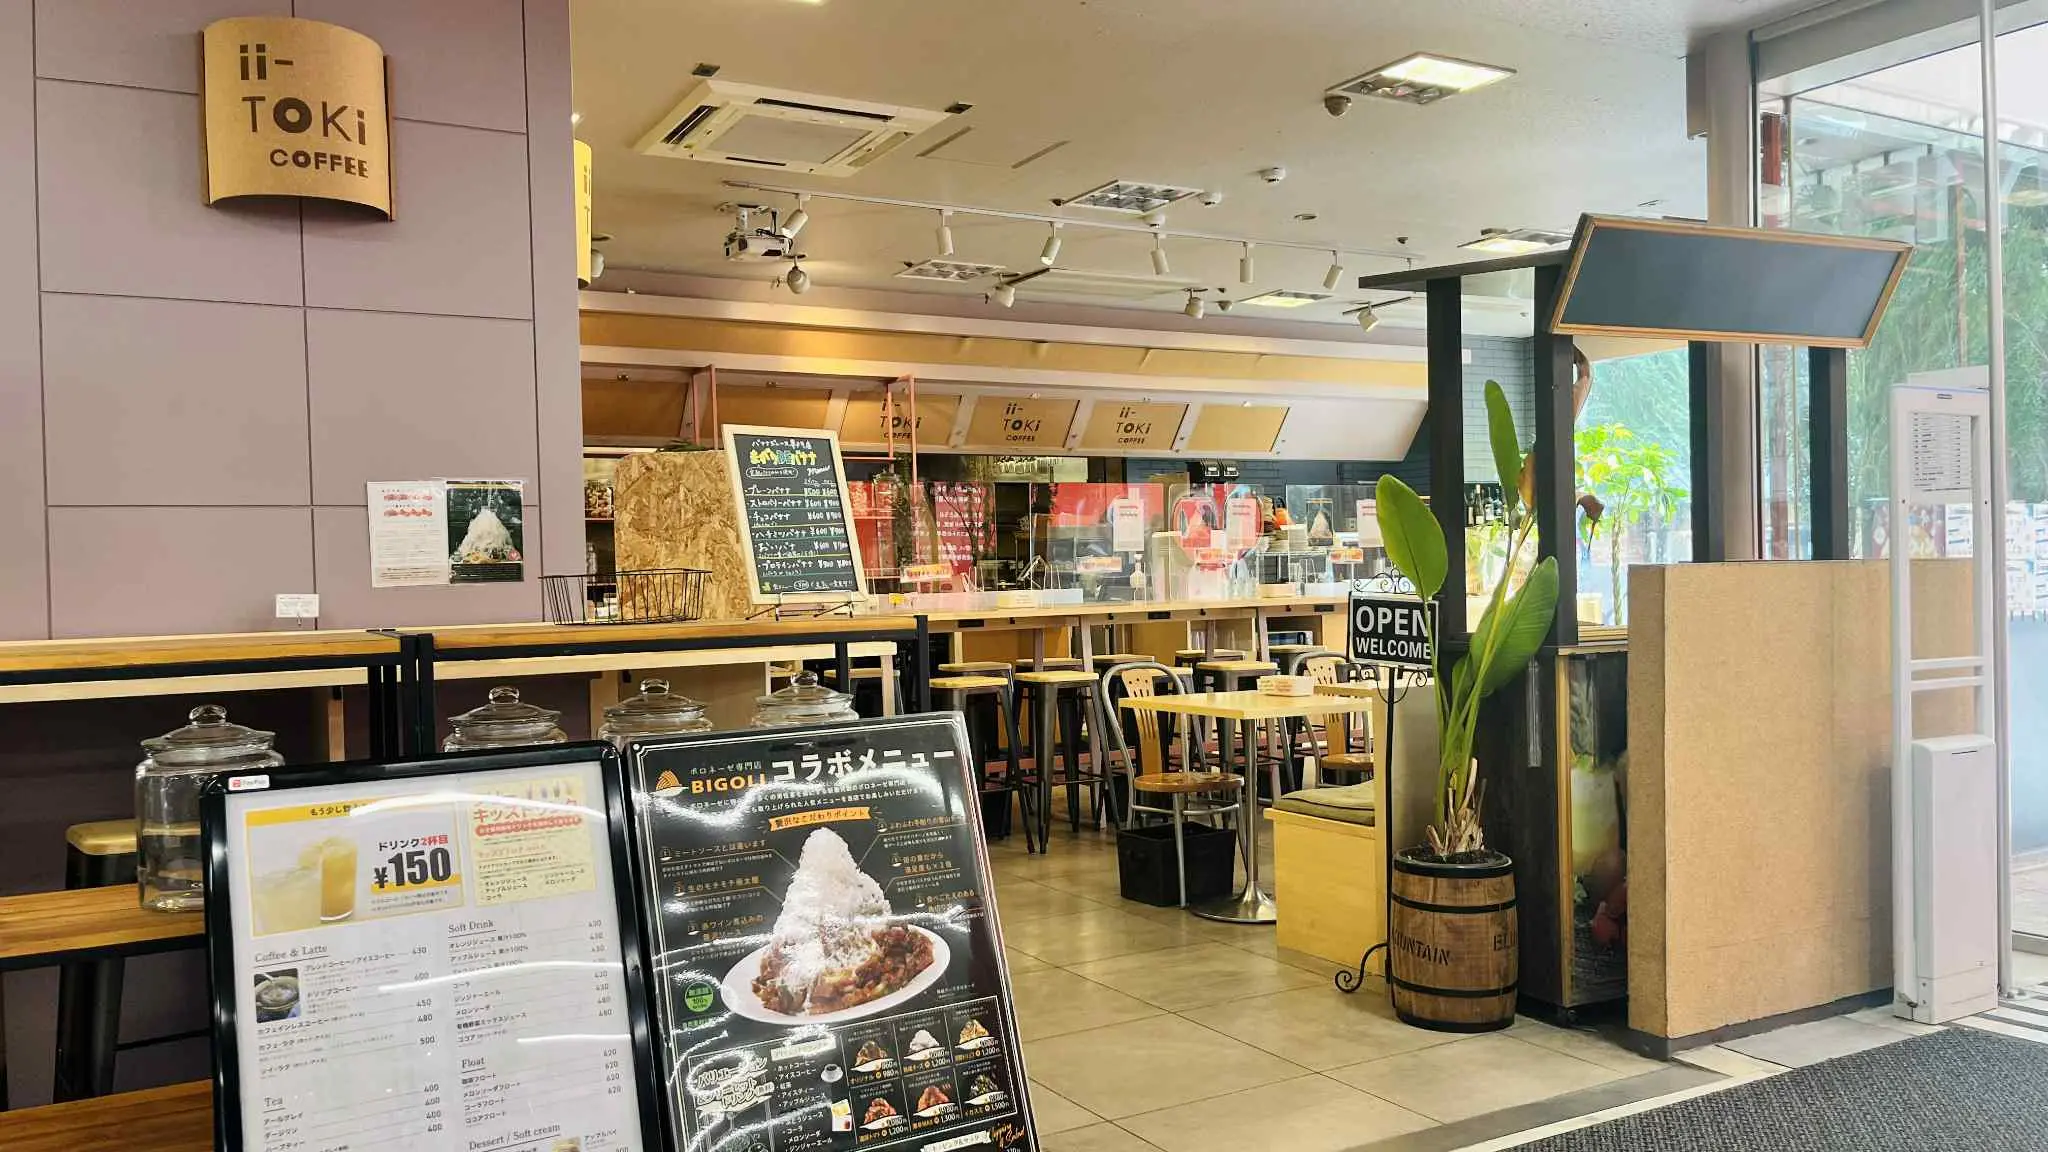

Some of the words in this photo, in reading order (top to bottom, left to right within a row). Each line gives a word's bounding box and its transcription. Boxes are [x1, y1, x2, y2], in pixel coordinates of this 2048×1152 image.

[241, 95, 367, 146] TOKi
[269, 148, 369, 179] COFFEE
[1003, 418, 1041, 433] TOKi
[1355, 605, 1432, 638] OPEN
[1355, 636, 1433, 660] WELCOME
[771, 749, 955, 783] コラボメニュー
[373, 847, 452, 889] ¥150
[448, 923, 467, 935] Soft
[469, 919, 494, 932] Drink
[254, 950, 287, 963] Coffee
[461, 1057, 485, 1069] Float
[469, 1134, 504, 1151] Dessert
[513, 1129, 531, 1142] Soft
[533, 1123, 561, 1137] cream
